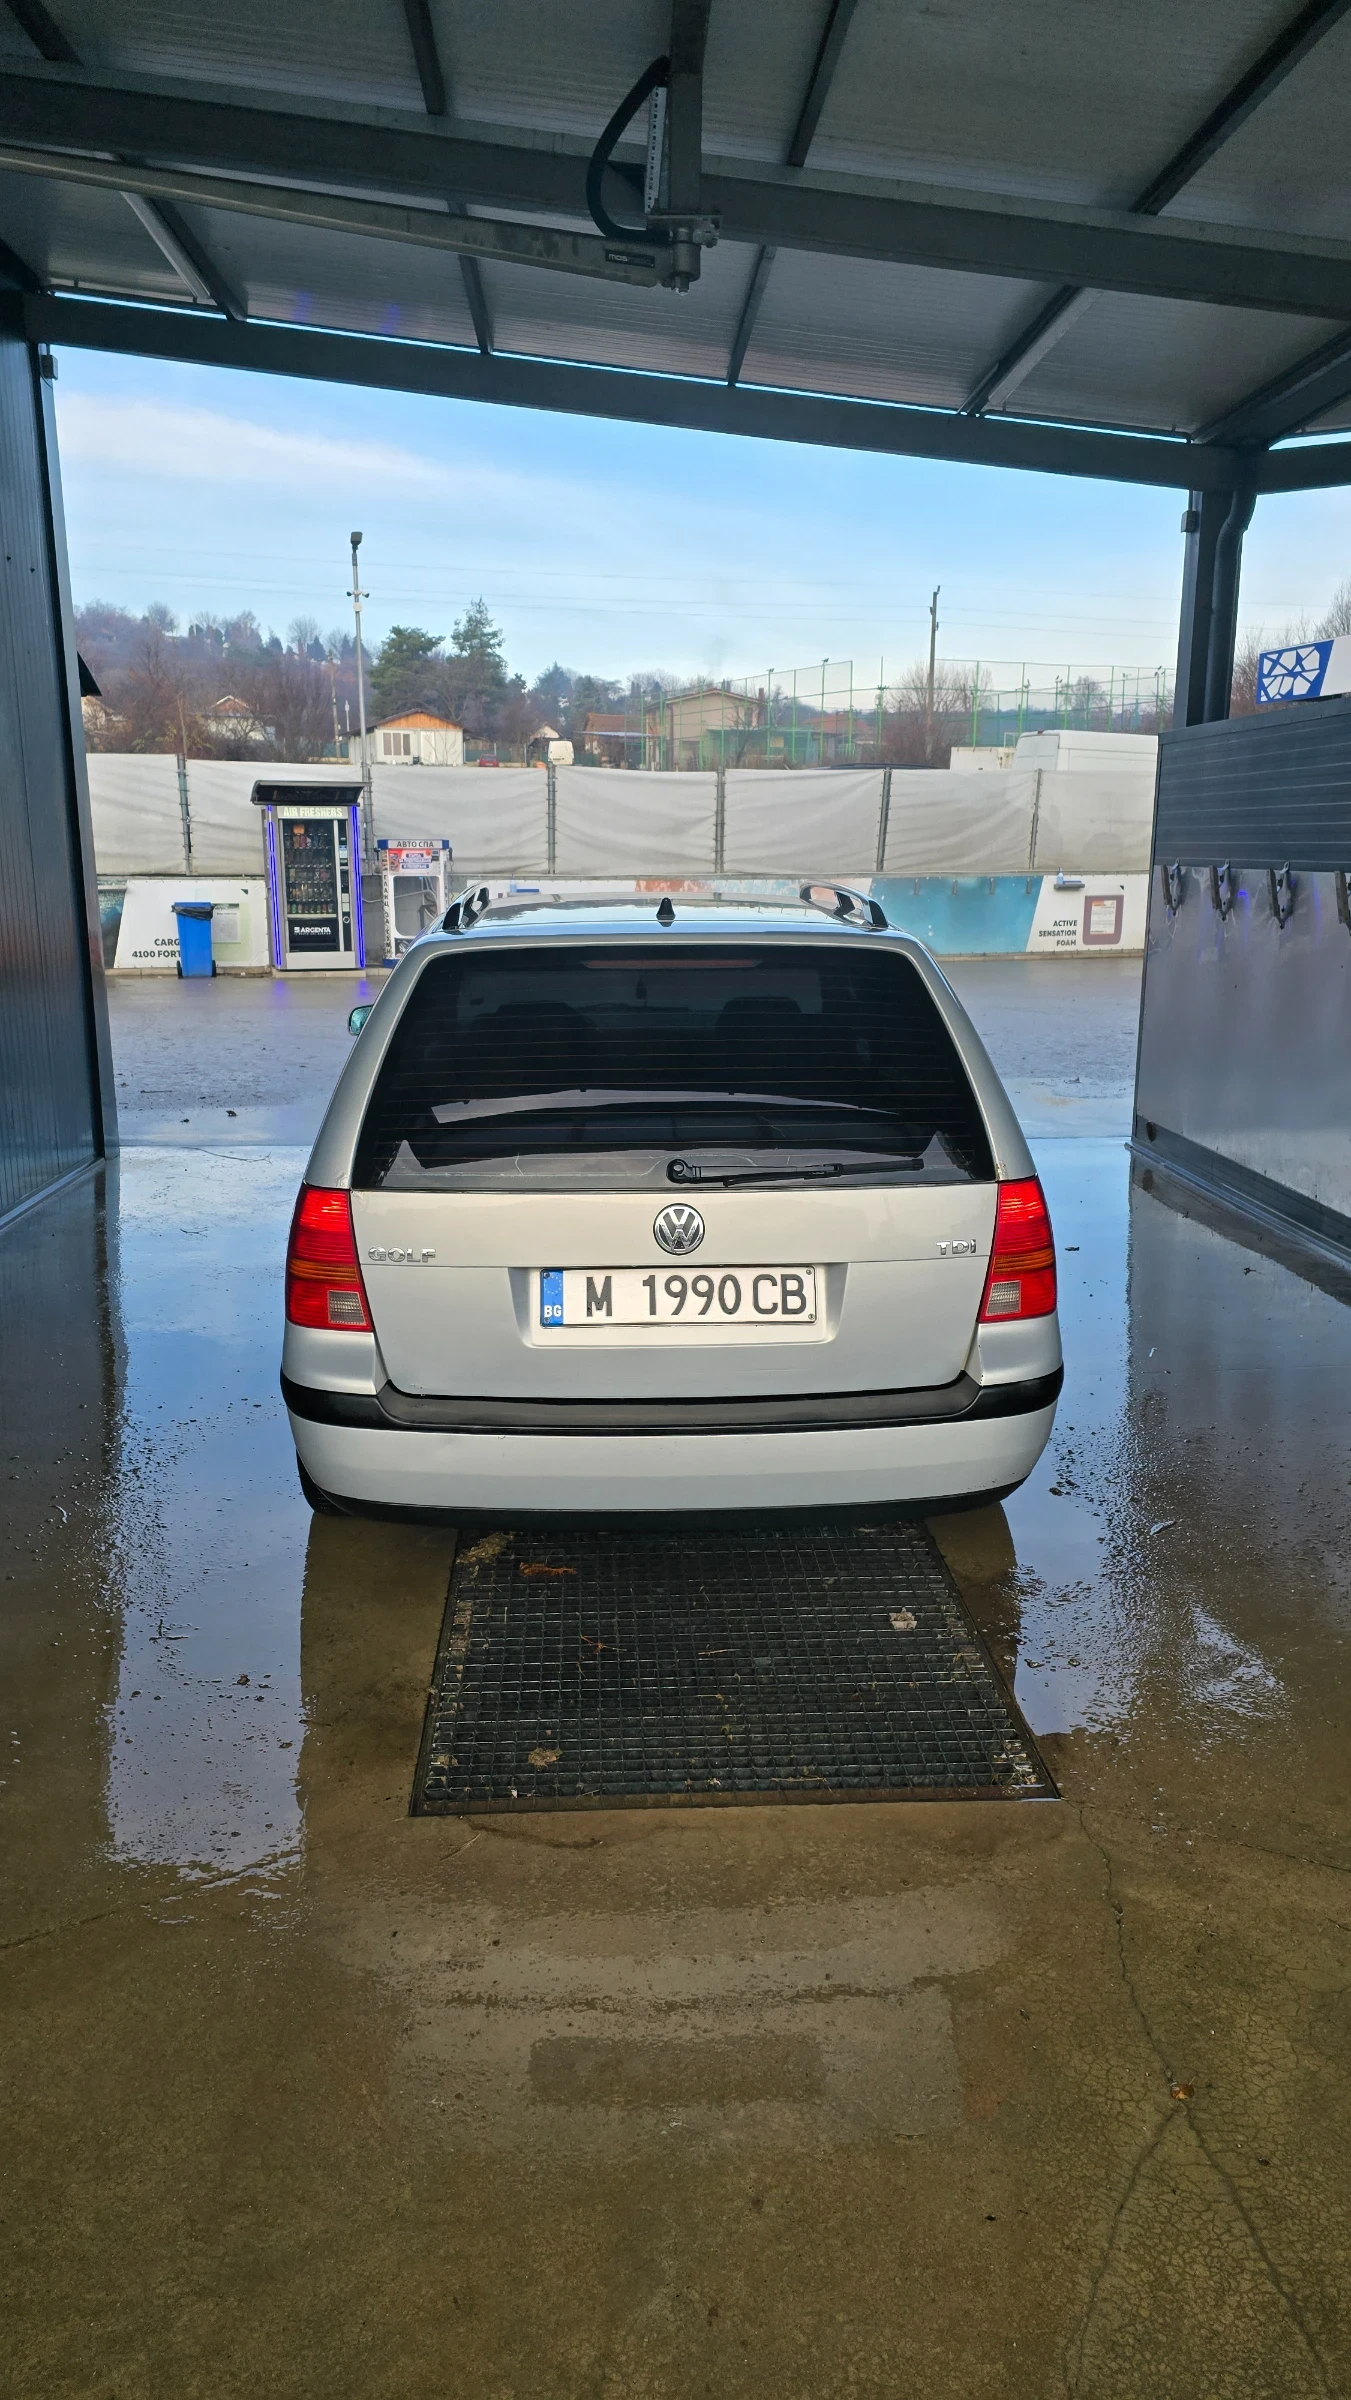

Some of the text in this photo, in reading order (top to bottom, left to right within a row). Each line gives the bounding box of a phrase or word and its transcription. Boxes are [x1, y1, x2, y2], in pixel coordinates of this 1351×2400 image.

[284, 807, 342, 817] AIR FRESHERS
[132, 950, 156, 958] 4100
[368, 1246, 436, 1263] GOLF
[586, 1273, 807, 1317] M 1990 CB
[544, 1304, 562, 1318] BG
